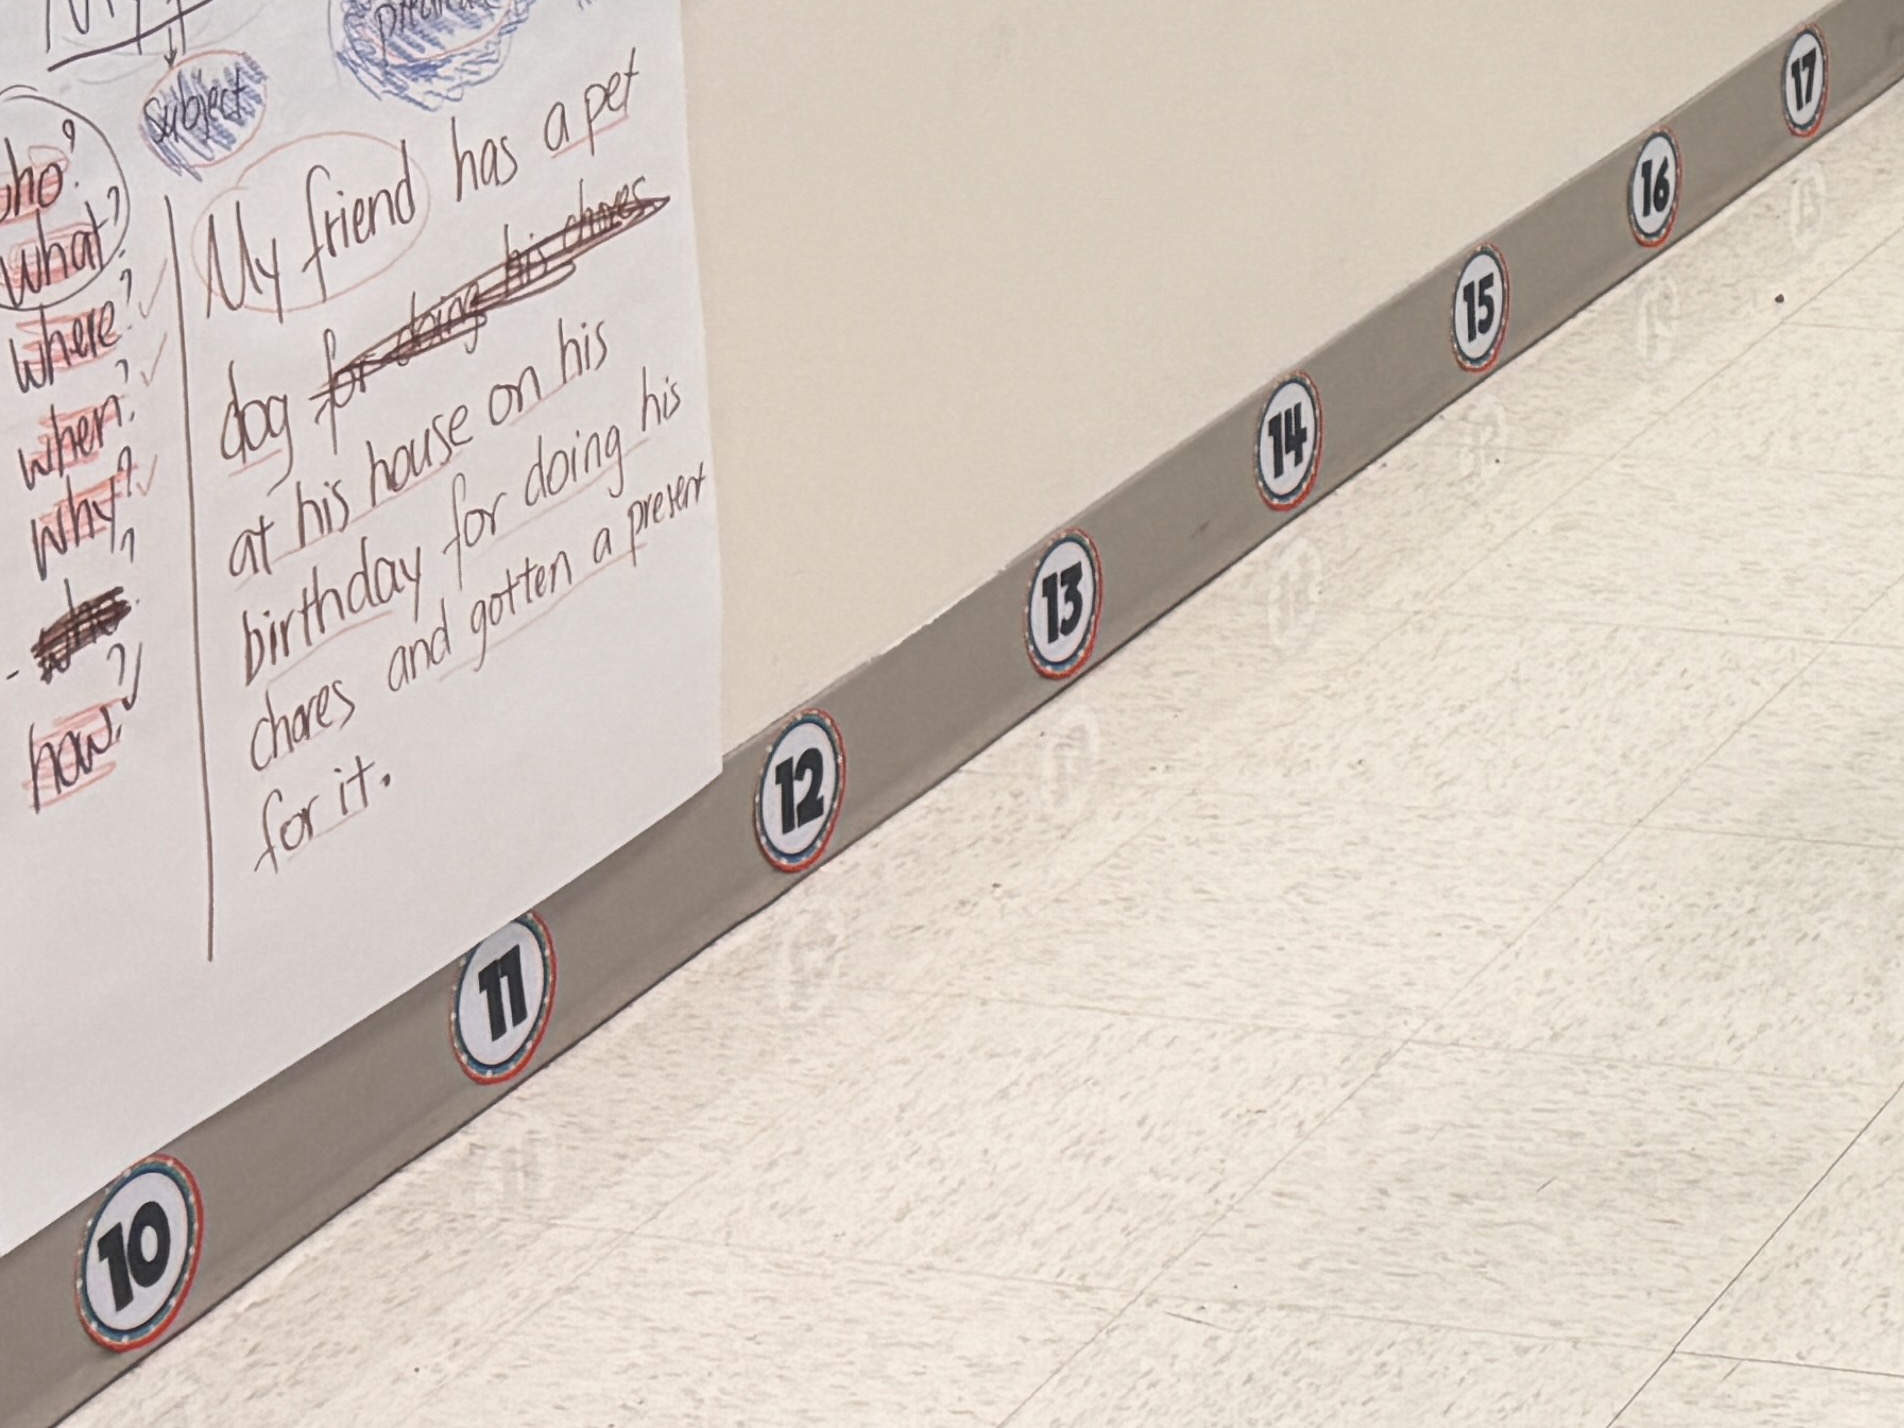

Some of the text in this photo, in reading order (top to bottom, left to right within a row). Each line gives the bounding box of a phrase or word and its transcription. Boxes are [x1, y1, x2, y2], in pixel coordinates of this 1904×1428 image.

[143, 73, 246, 142] subject
[1790, 47, 1816, 110] 17
[207, 47, 639, 323] My friend has a pet
[1641, 156, 1669, 217] 16
[1463, 272, 1495, 342] 15
[221, 361, 292, 495] dog
[228, 318, 608, 578] at his house on his
[1267, 401, 1308, 478] 14
[242, 536, 422, 686] birthday
[442, 472, 504, 589] for
[523, 420, 624, 507] doing
[640, 366, 683, 433] his
[249, 460, 706, 773] chores and gotten a present
[1042, 561, 1083, 644] 13
[254, 754, 393, 873] for it.
[775, 748, 824, 834] 12
[480, 945, 526, 1041] 11
[97, 1199, 171, 1312] 10
